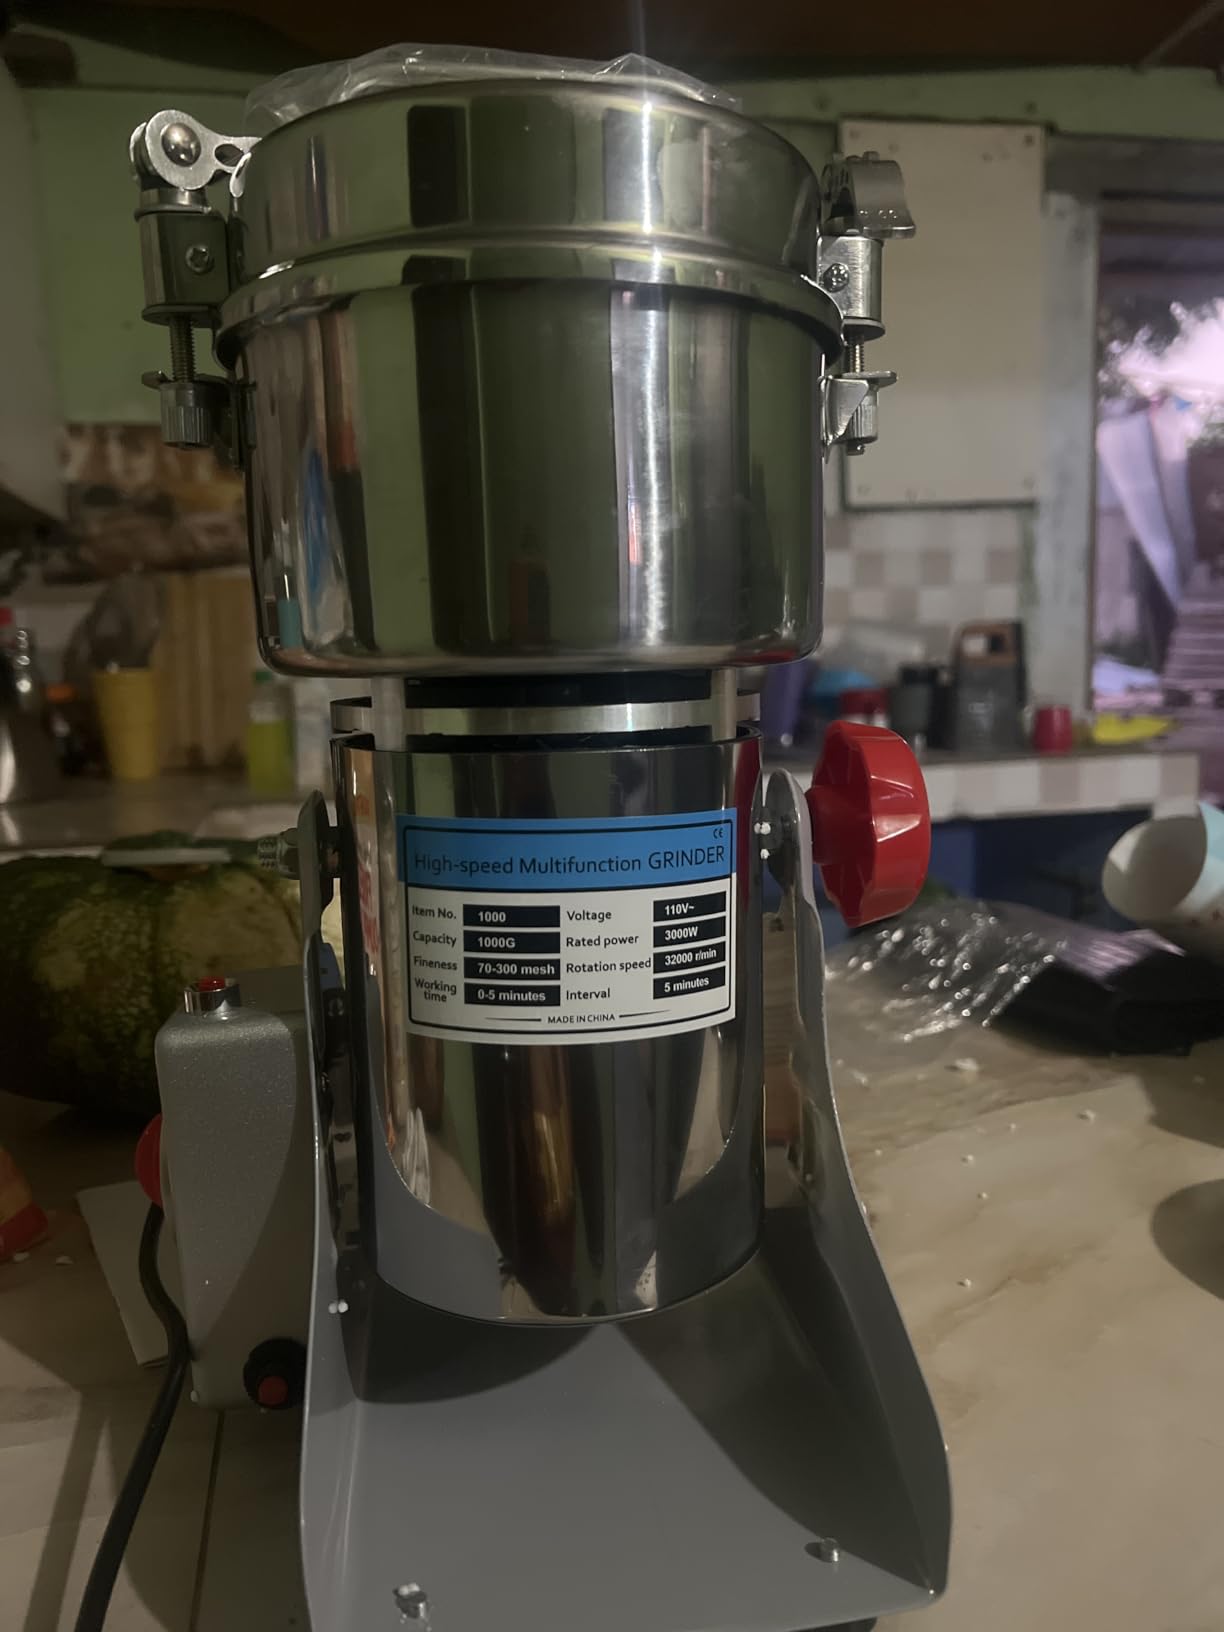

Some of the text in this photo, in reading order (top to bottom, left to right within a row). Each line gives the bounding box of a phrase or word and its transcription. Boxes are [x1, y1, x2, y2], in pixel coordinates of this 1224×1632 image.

[414, 845, 725, 877] High-speed Multifunction GRINDER
[412, 906, 456, 919] Item No.
[664, 903, 695, 915] 110V~
[478, 911, 506, 923] 1000
[567, 909, 612, 924] Voltage
[413, 931, 457, 947] Capacity
[664, 926, 699, 940] 3000W
[478, 936, 515, 948] 1000G
[566, 935, 639, 950] Rated power
[414, 956, 458, 970] Fineness
[664, 948, 717, 966] 32000 r/min
[478, 963, 555, 975] 70-300 mesh
[566, 957, 652, 973] Rotation speed
[414, 978, 457, 995] Working
[664, 976, 709, 992] 5 minutes
[424, 990, 447, 1002] time
[478, 989, 546, 1002] 0-5 minutes
[566, 988, 611, 1000] Interval
[547, 1015, 574, 1024] MADE
[587, 1014, 615, 1022] CHINA
